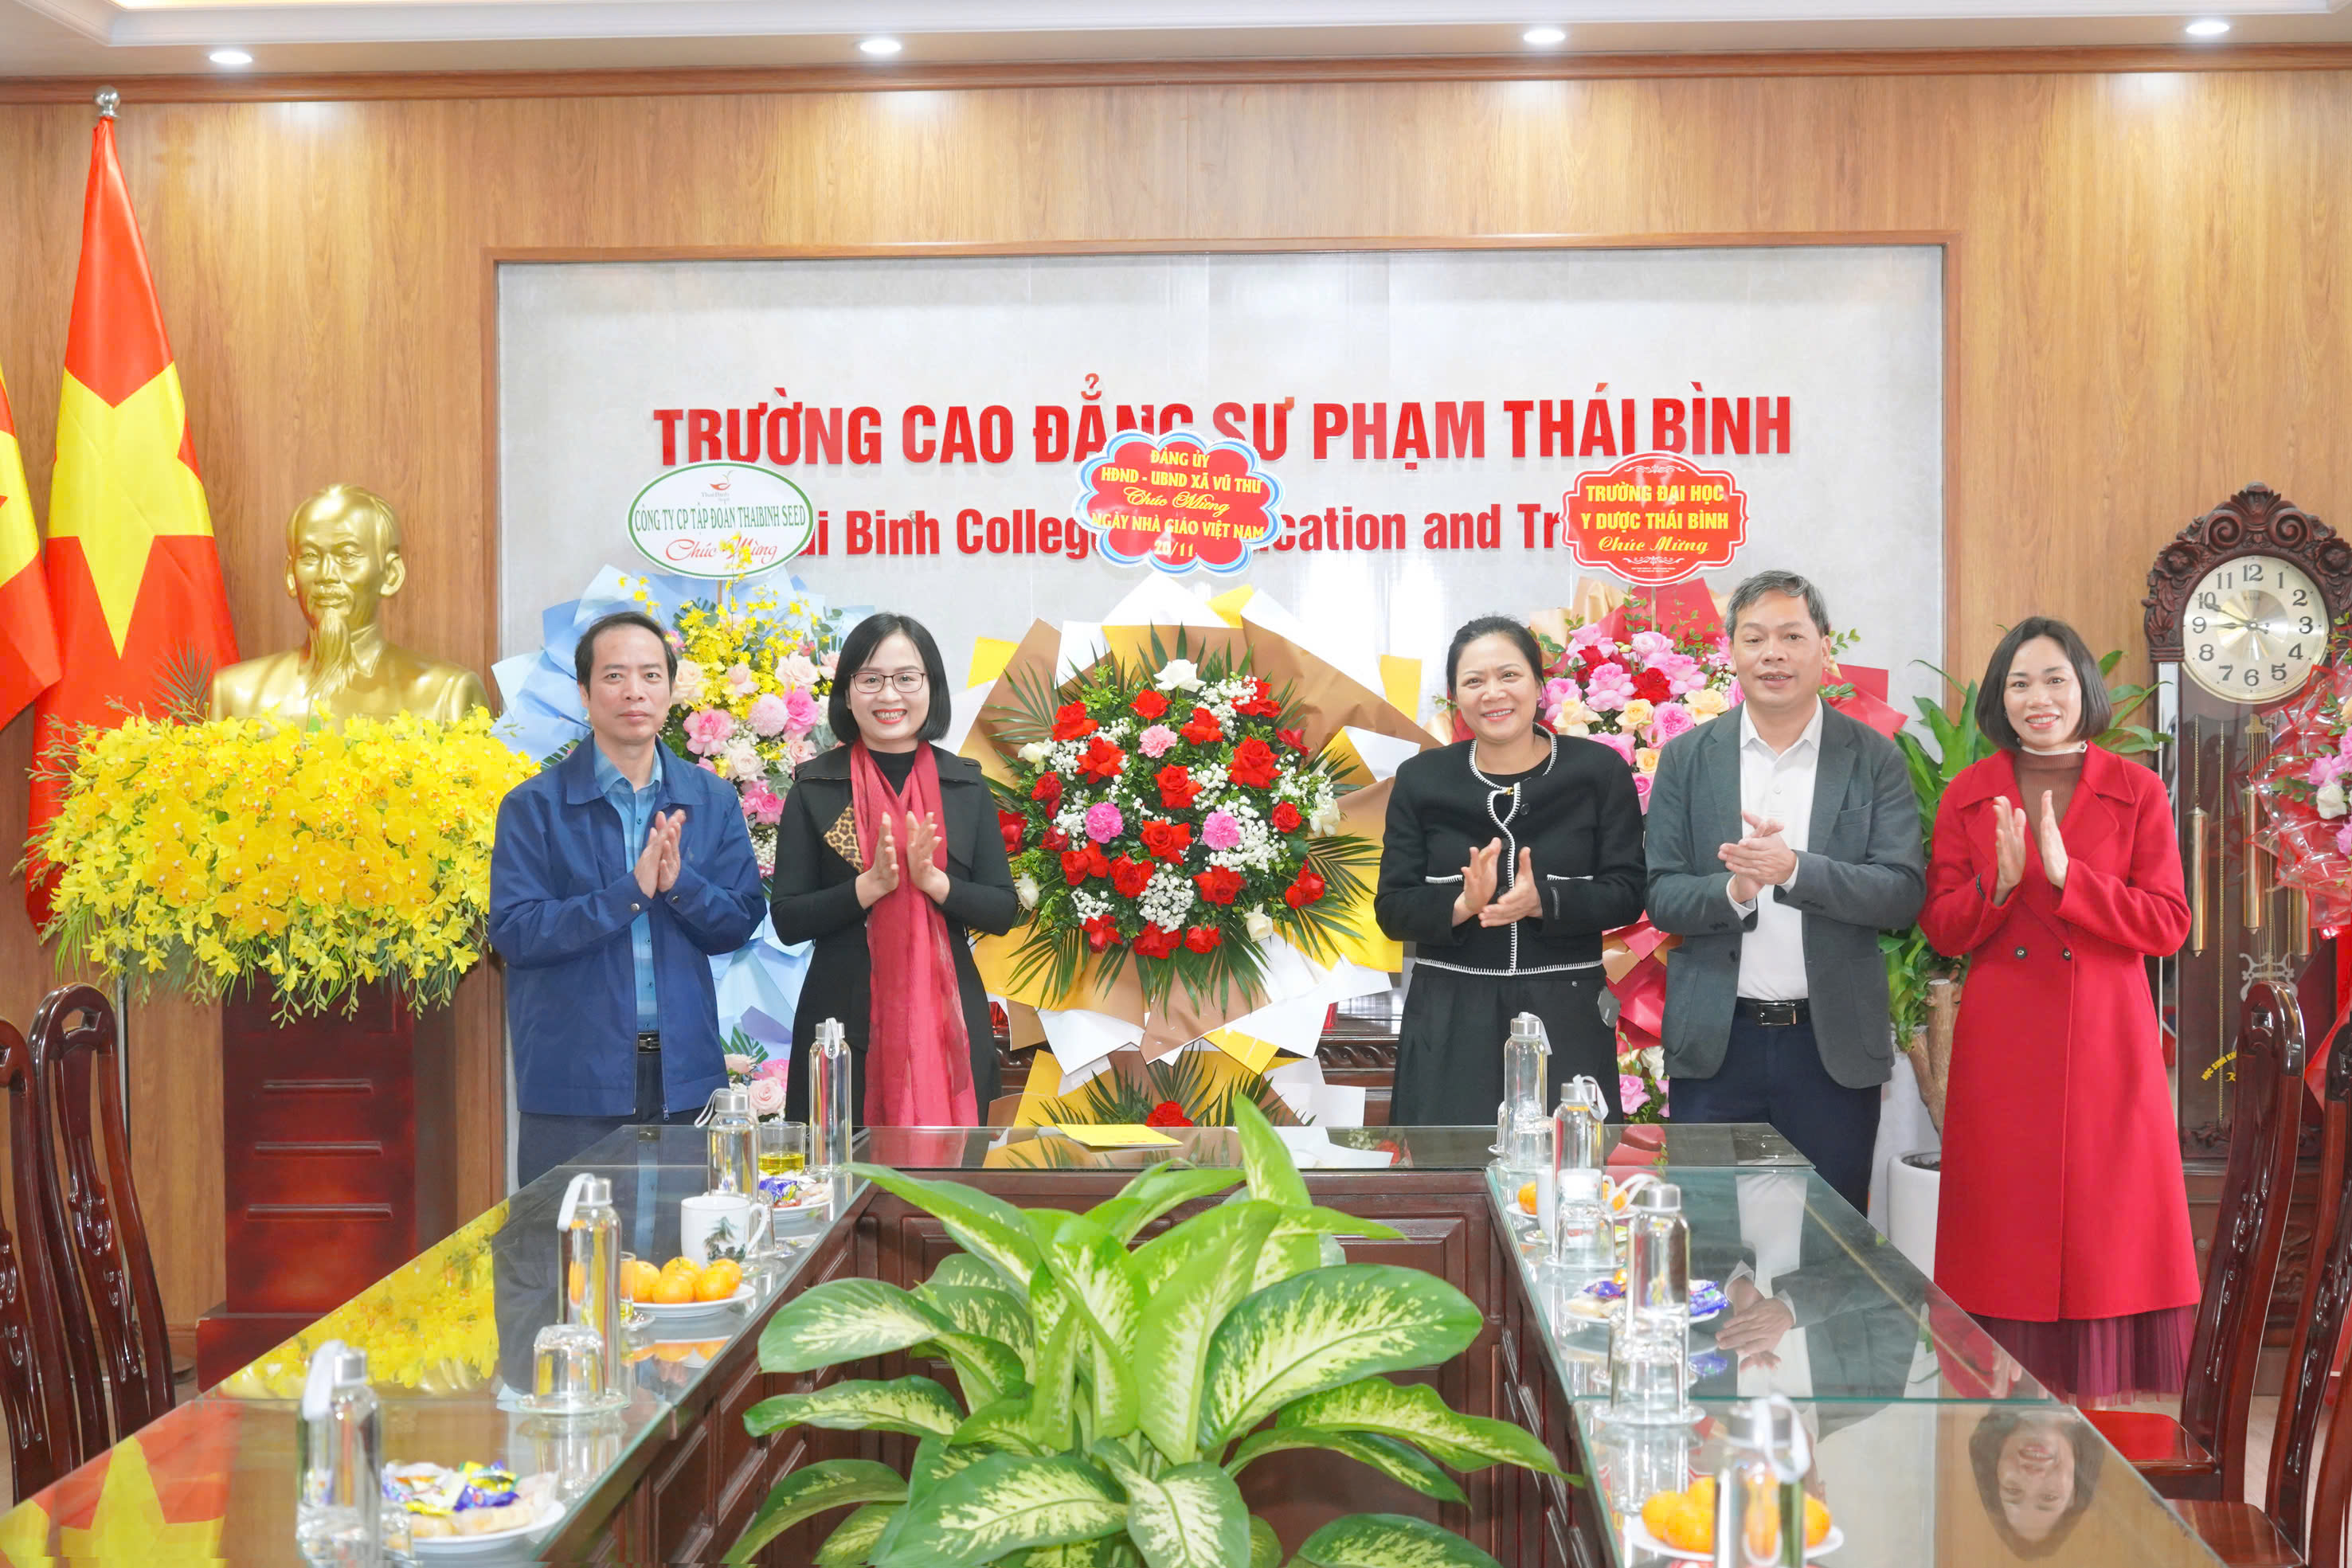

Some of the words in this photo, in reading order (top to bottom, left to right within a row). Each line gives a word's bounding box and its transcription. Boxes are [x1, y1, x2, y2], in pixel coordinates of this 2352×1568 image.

[653, 387, 882, 466] TRƯỜNG
[902, 405, 1015, 464] CAO
[1212, 396, 1295, 462] SƯ
[1313, 400, 1485, 471] PHẠM
[1503, 382, 1635, 458] THÁI
[1652, 381, 1791, 456] BÌNH
[1151, 447, 1189, 466] ĐẢNG
[1192, 449, 1210, 468] ỦY
[1101, 467, 1139, 483] HĐND
[1151, 471, 1188, 487] UBND
[1191, 471, 1209, 490] XÃ
[1212, 474, 1231, 491] VŨ
[1585, 481, 1653, 502] TRƯỜNG
[1657, 485, 1685, 505] ĐẠI
[1690, 484, 1724, 505] HỌC
[1123, 487, 1168, 506] Chúc
[1172, 491, 1230, 518] Mừng
[635, 503, 660, 532] CÔNG
[662, 509, 674, 530] TY
[677, 508, 688, 530] CP
[691, 502, 708, 535] TẬP
[711, 501, 736, 529] ĐOÀN
[738, 505, 781, 528] THAIBINH
[781, 504, 806, 526] SEED
[1091, 511, 1129, 530] NGÀY
[1132, 513, 1160, 533] NHÀ
[1164, 516, 1199, 535] GIÁO
[1202, 520, 1231, 540] VIỆT
[1233, 525, 1265, 540] NAM
[1581, 513, 1592, 529] Y
[1596, 510, 1641, 533] DƯỢC
[1646, 510, 1685, 530] THÁI
[1688, 510, 1728, 530] BÌNH
[846, 510, 940, 556] Binh
[956, 508, 1098, 560] Colleg
[1254, 506, 1407, 551] cation
[1423, 503, 1501, 549] and
[665, 538, 717, 561] Chúc
[1599, 536, 1646, 552] Chúc
[1650, 535, 1708, 554] Mừng
[2217, 572, 2233, 589] 11
[2243, 564, 2264, 581] 12
[2278, 572, 2284, 589] 1
[2198, 592, 2217, 609] 10
[2292, 589, 2308, 606] 2
[2192, 616, 2207, 634] 9
[2299, 616, 2314, 634] 3
[2198, 643, 2214, 661] 8
[2288, 642, 2303, 660] 4
[2218, 664, 2233, 681] 7
[2244, 669, 2260, 686] 6
[2272, 663, 2287, 681] 5
